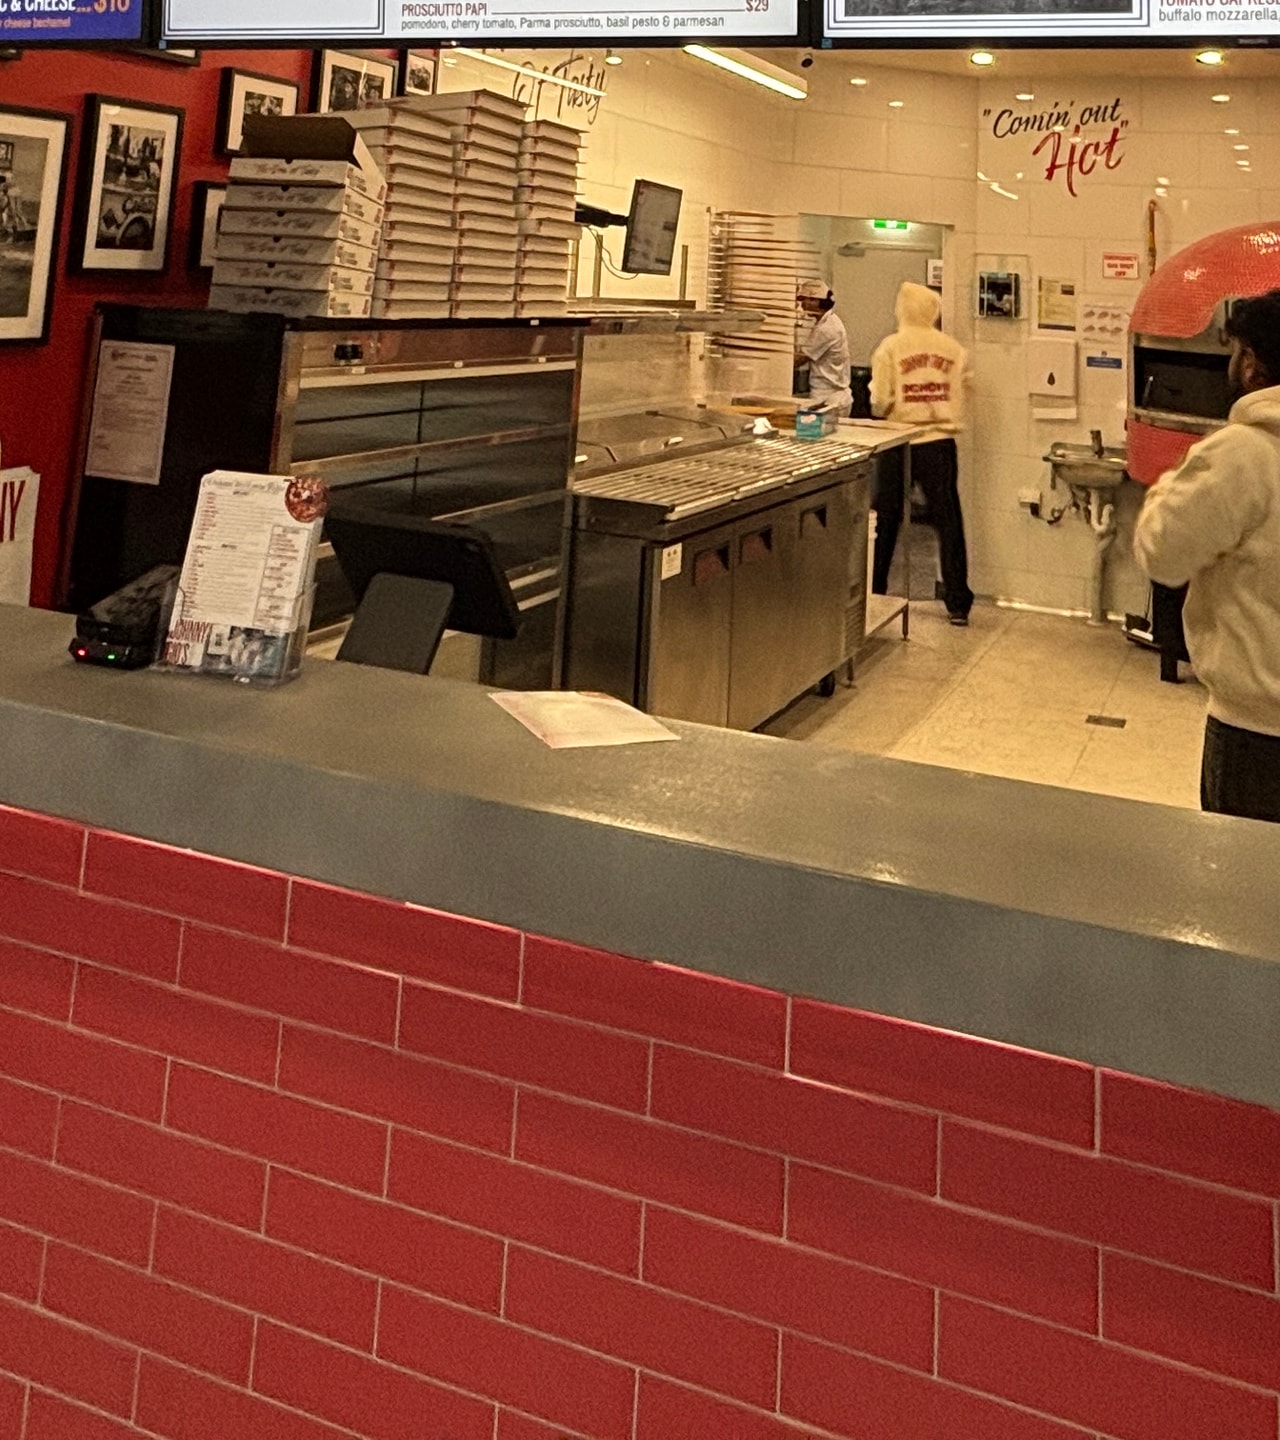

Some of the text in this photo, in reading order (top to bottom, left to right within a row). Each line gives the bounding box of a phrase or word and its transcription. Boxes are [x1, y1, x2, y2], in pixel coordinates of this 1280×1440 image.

[401, 2, 462, 17] PROSCIUTTO
[465, 2, 487, 16] PAPI
[1158, 8, 1202, 22] buffalo
[1080, 98, 1122, 126] out
